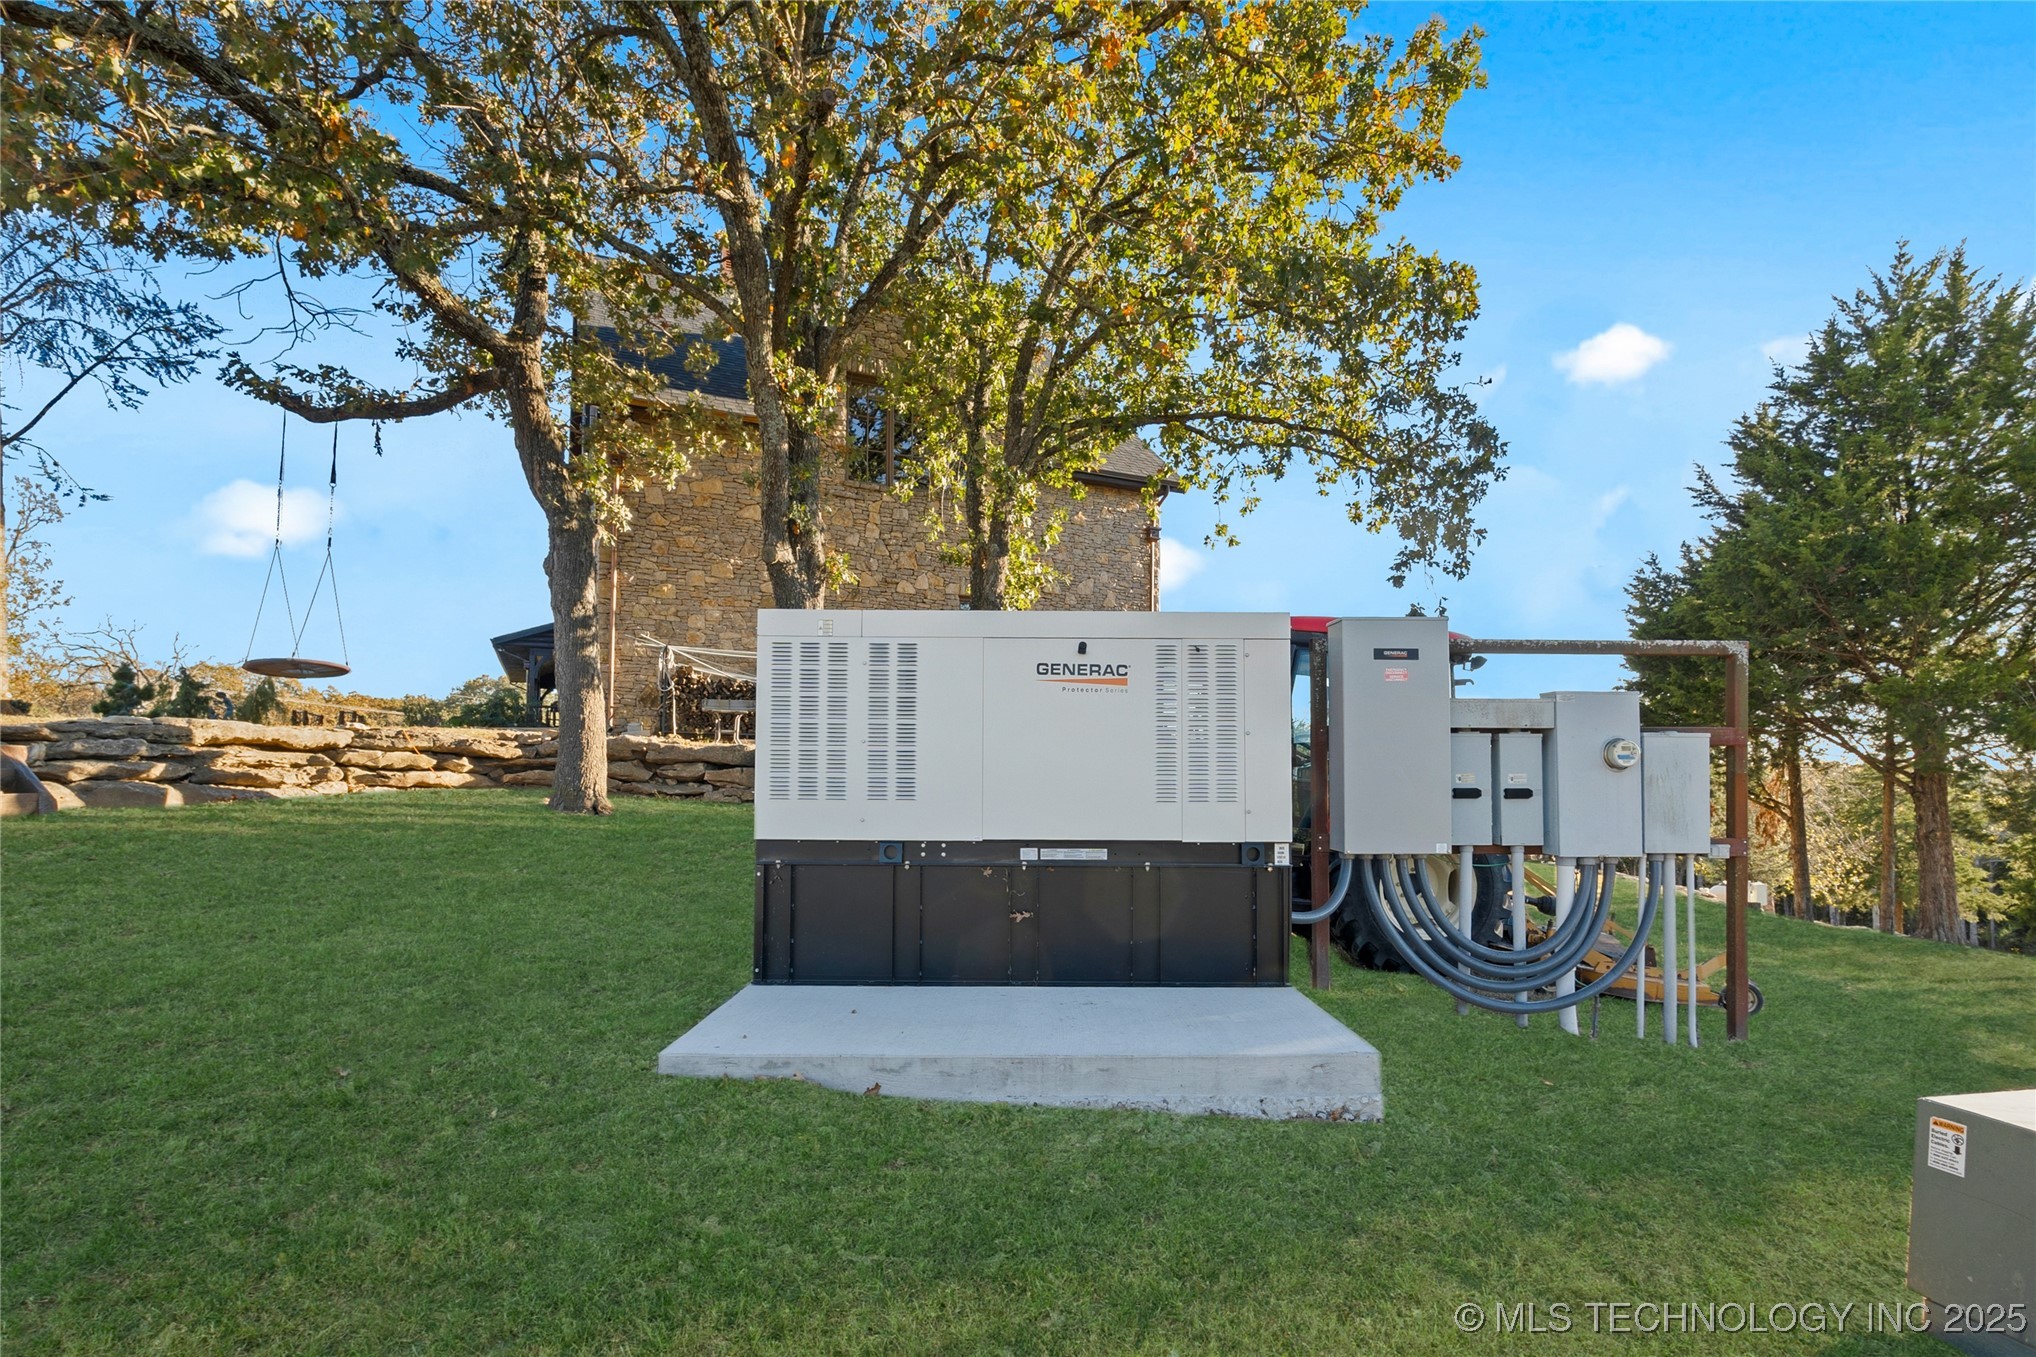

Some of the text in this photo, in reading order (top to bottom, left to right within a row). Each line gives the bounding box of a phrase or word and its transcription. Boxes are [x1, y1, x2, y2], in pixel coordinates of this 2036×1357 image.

[1036, 662, 1129, 677] GENERAC
[1931, 1128, 1948, 1137] Buried
[1938, 1120, 1965, 1134] WARNING
[1931, 1134, 1950, 1143] Electric
